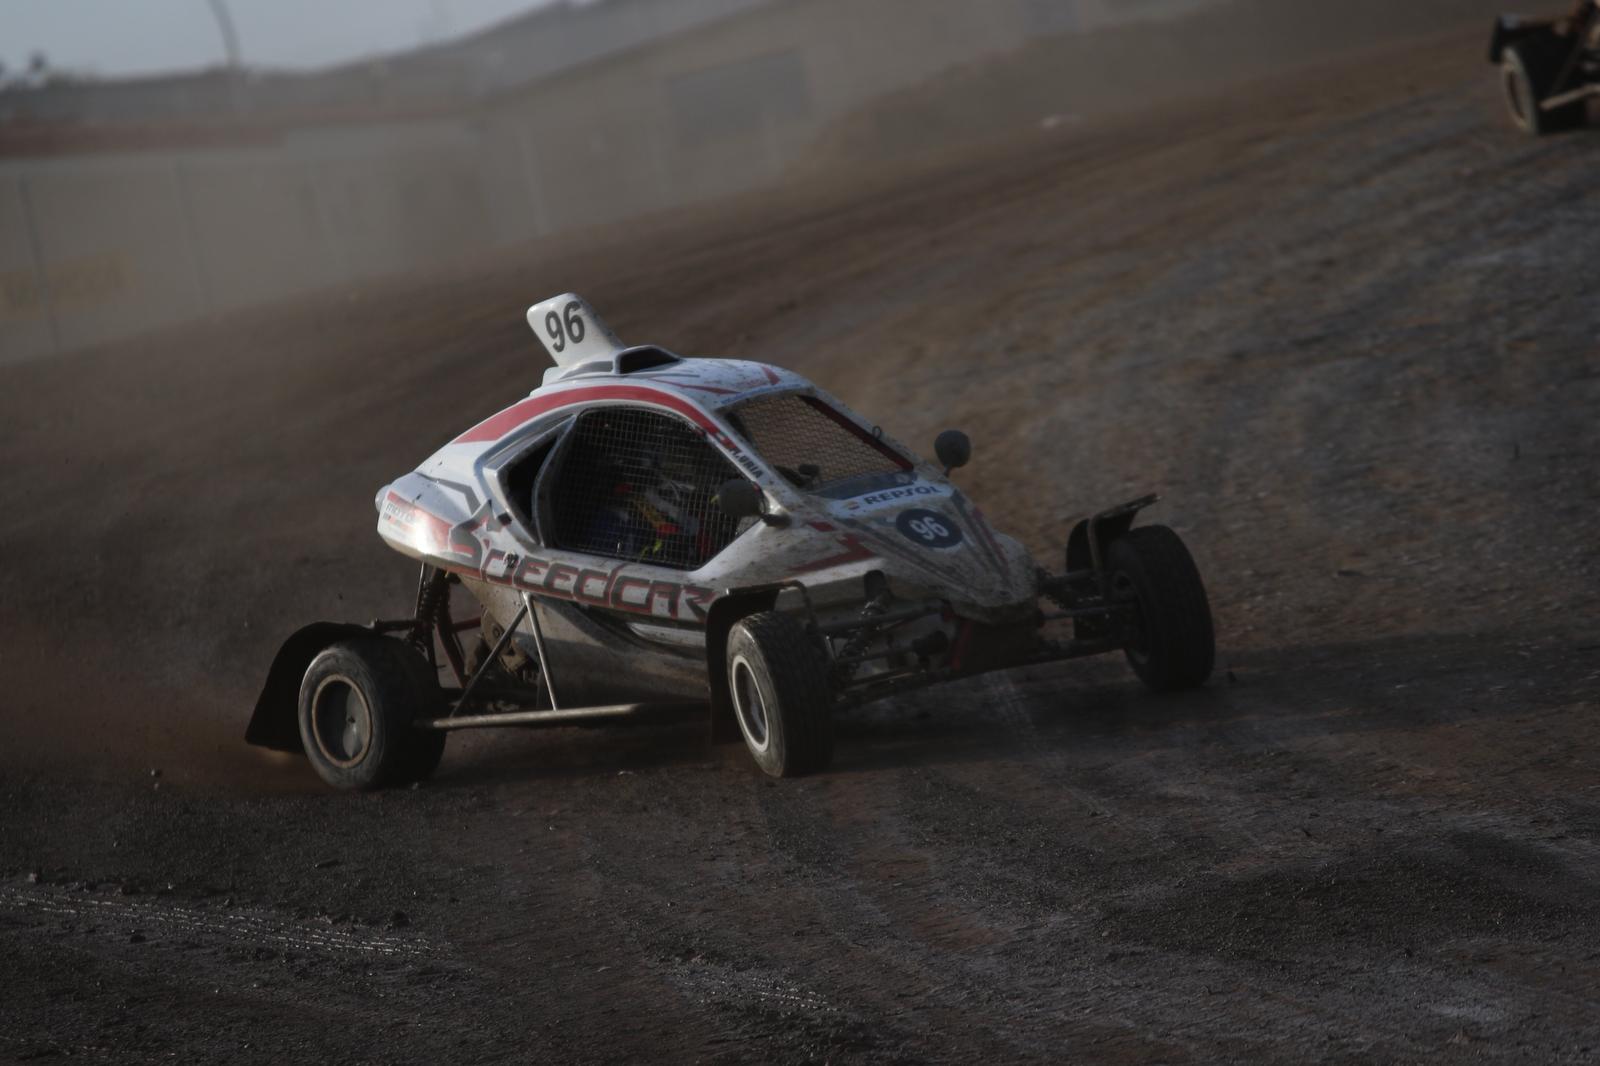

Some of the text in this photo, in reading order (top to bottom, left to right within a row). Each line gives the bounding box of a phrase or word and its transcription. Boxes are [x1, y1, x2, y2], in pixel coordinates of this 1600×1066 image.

[545, 301, 585, 353] 96
[864, 486, 942, 505] REPSOL
[908, 516, 949, 540] 96
